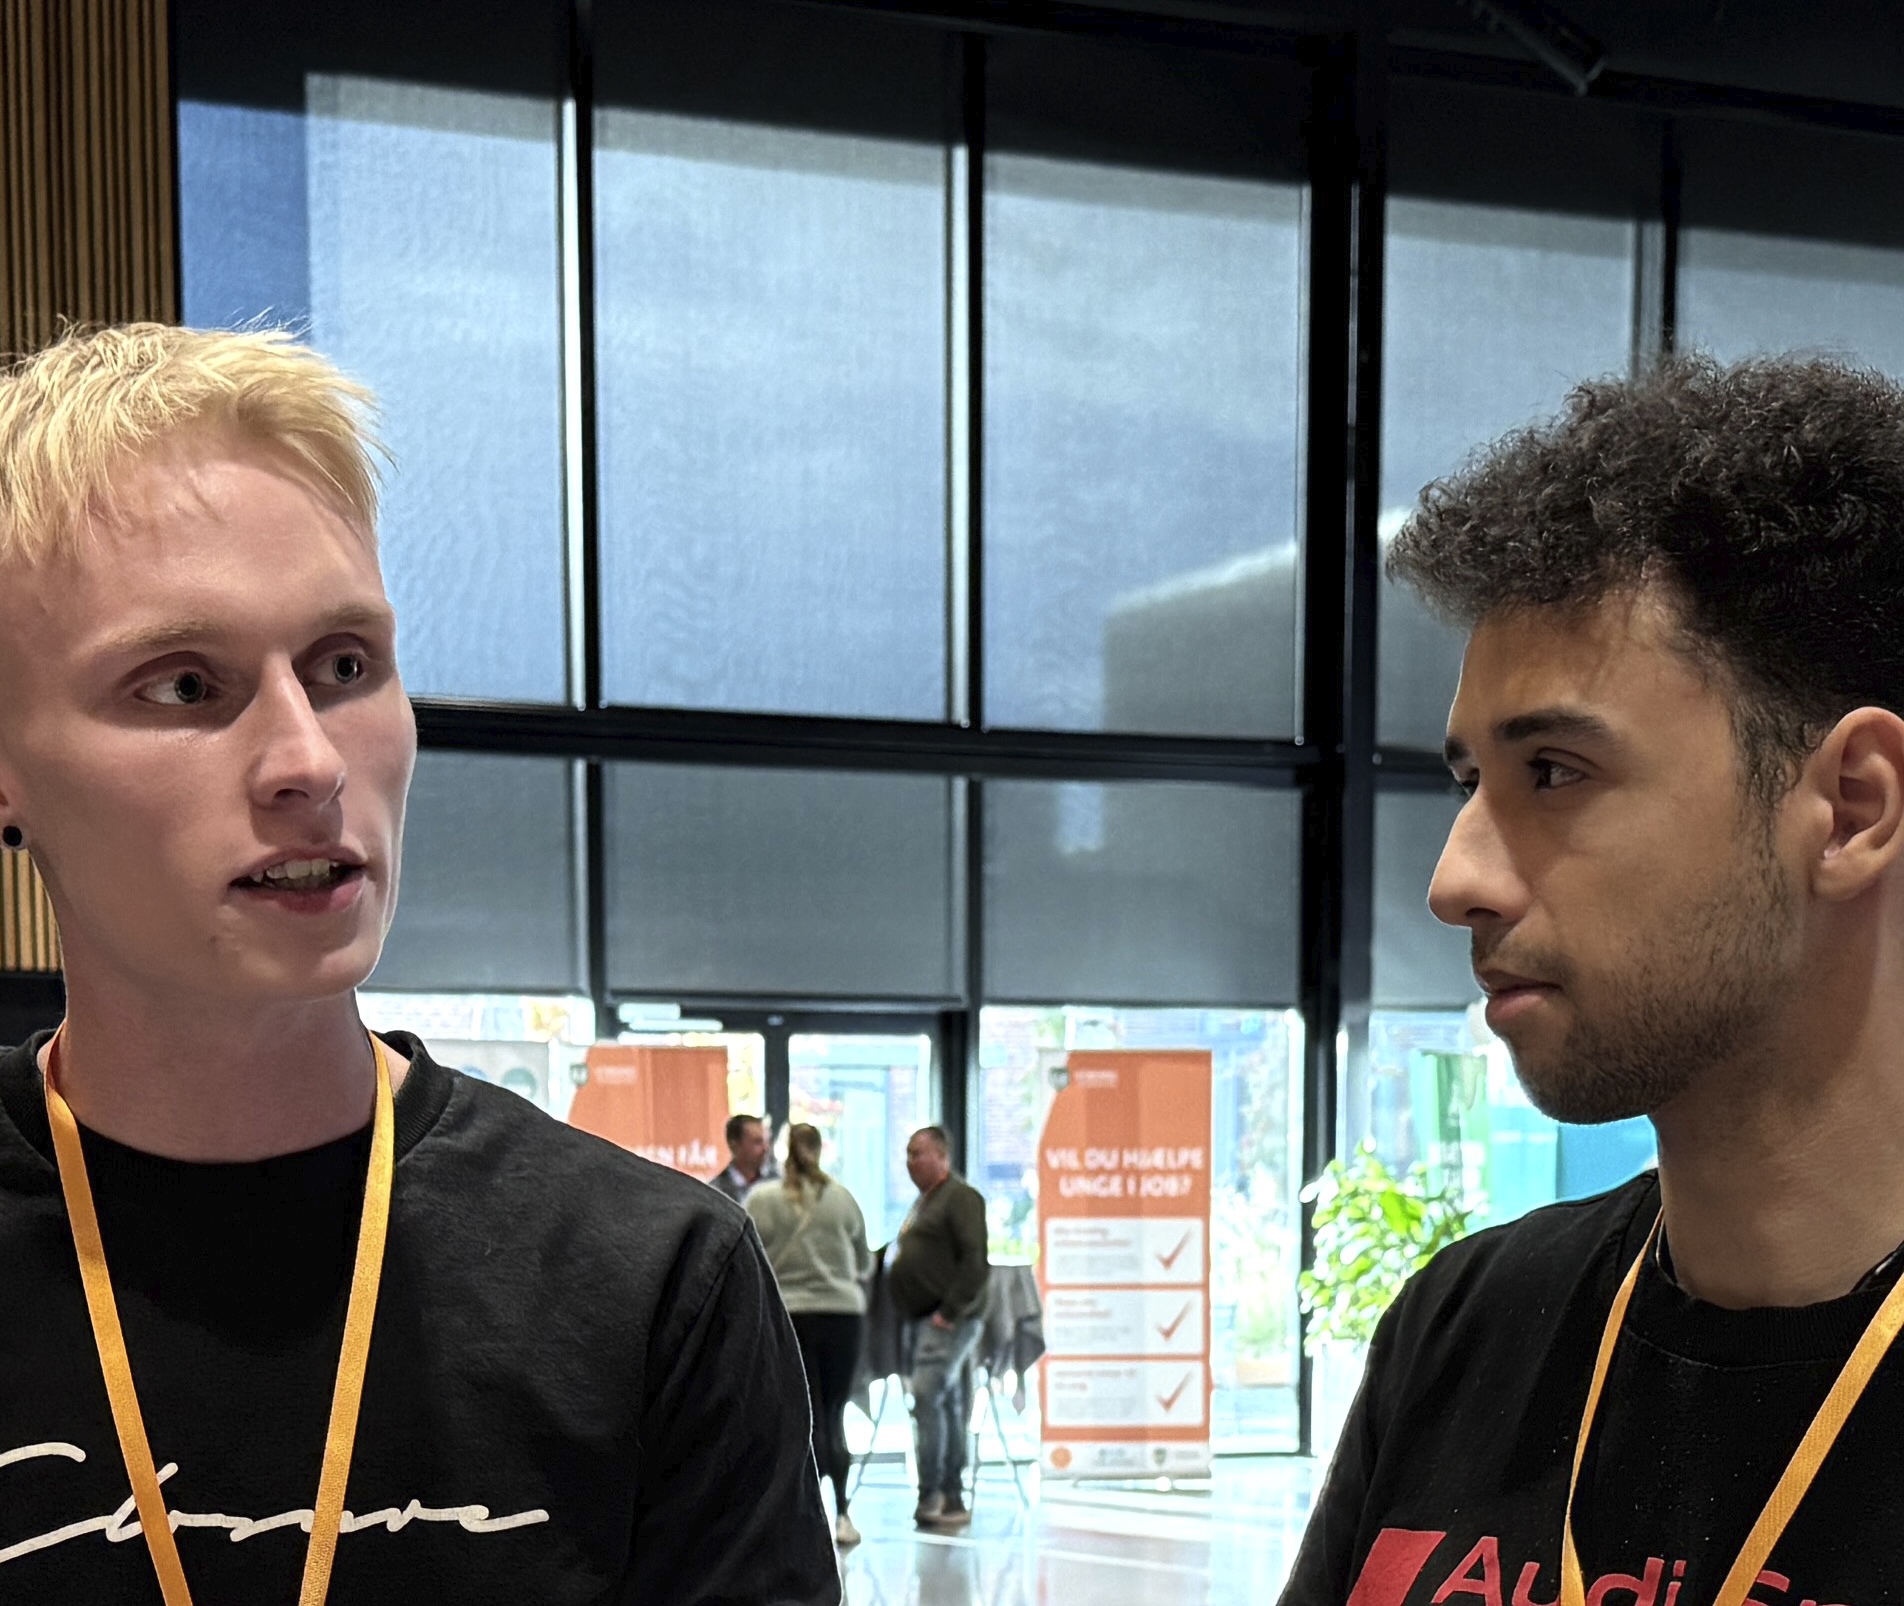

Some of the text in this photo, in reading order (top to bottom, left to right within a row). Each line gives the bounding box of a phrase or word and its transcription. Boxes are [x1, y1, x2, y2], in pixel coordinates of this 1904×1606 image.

[1046, 1147, 1079, 1170] VIL
[1083, 1147, 1119, 1170] DU
[1059, 1174, 1123, 1197] UNGE
